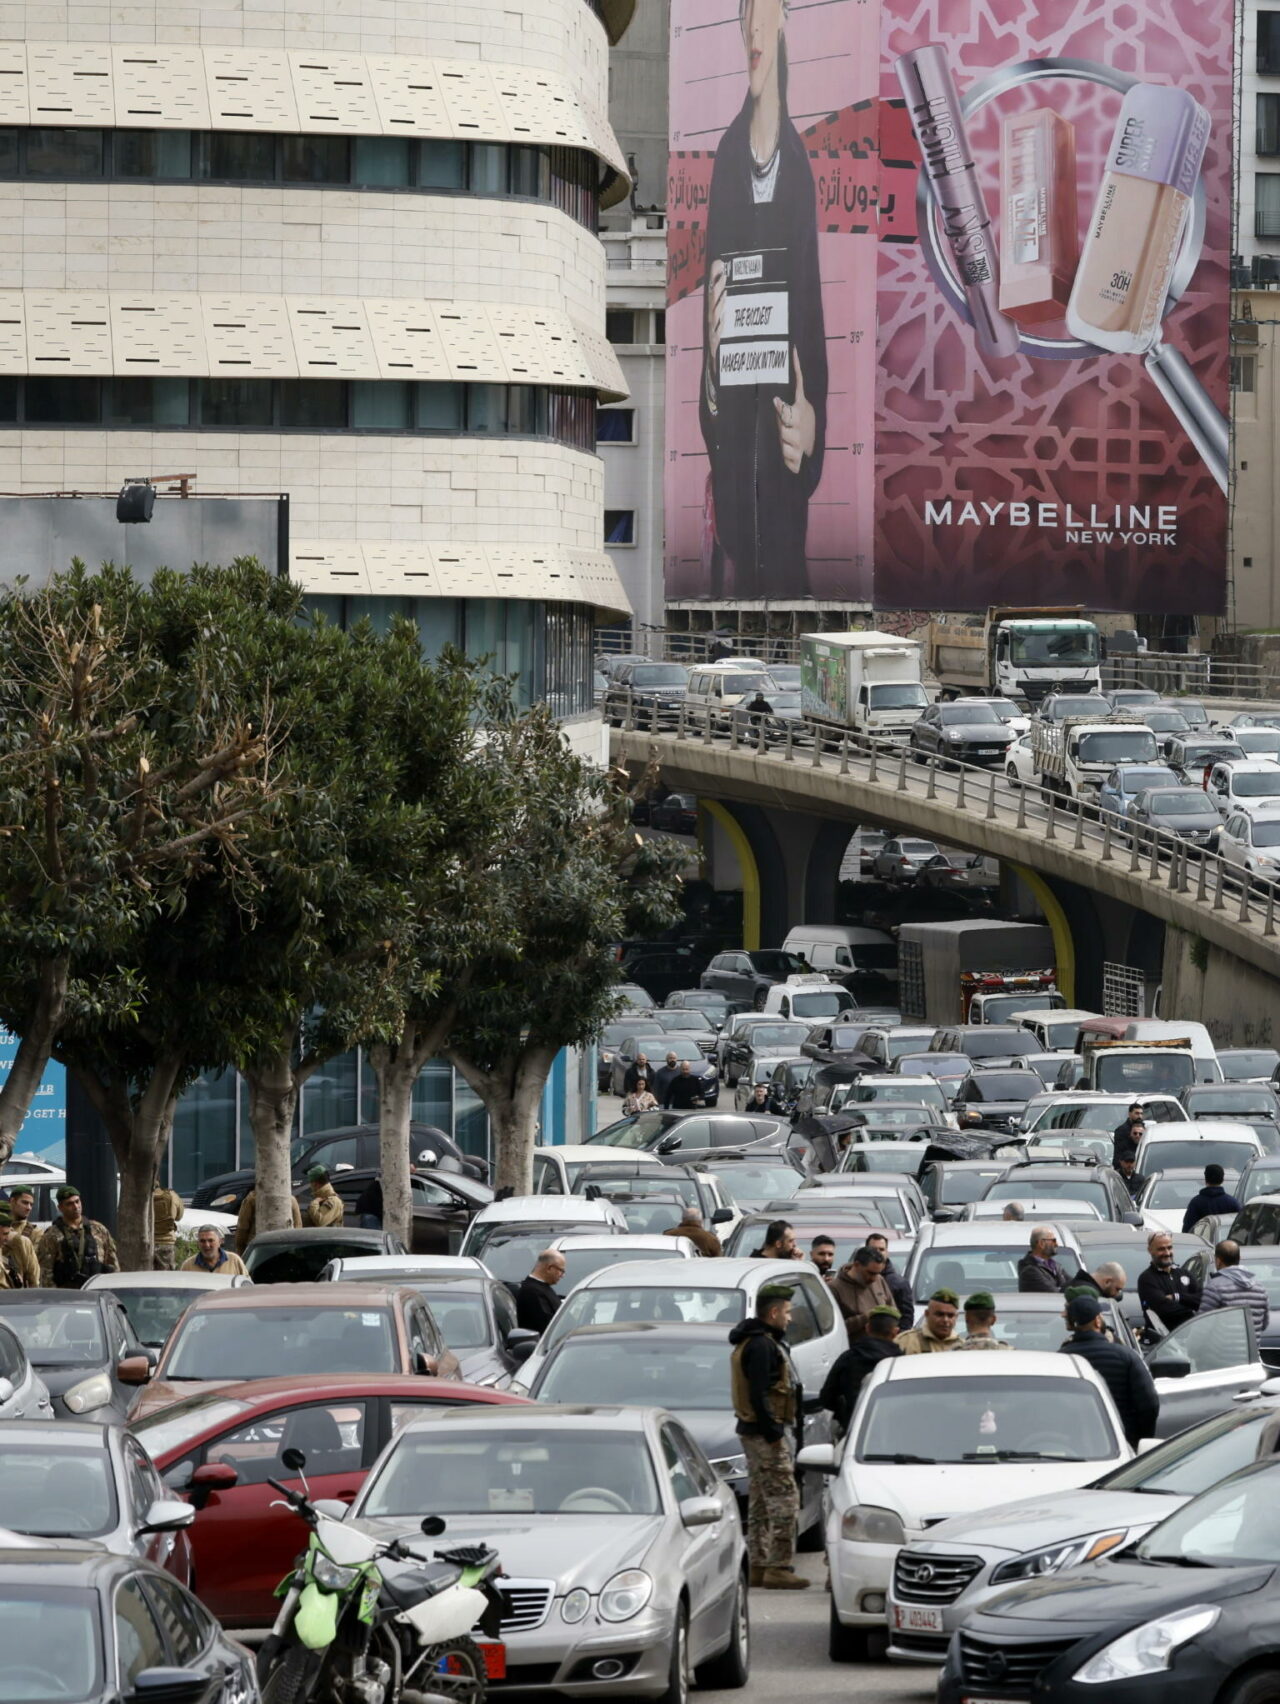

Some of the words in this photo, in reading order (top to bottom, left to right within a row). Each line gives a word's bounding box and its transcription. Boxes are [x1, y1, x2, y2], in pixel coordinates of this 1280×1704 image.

[1116, 118, 1145, 167] SUPER
[1095, 183, 1115, 239] MAYBELLINE
[1110, 272, 1131, 291] 30H
[734, 307, 746, 328] THE
[721, 351, 746, 373] MAKEUP
[746, 351, 761, 371] LOOK
[768, 350, 787, 368] TOWN
[924, 501, 1178, 530] MAYBELLINE
[1066, 531, 1114, 544] NEW
[1120, 532, 1177, 546] YORK
[33, 1109, 56, 1119] GET
